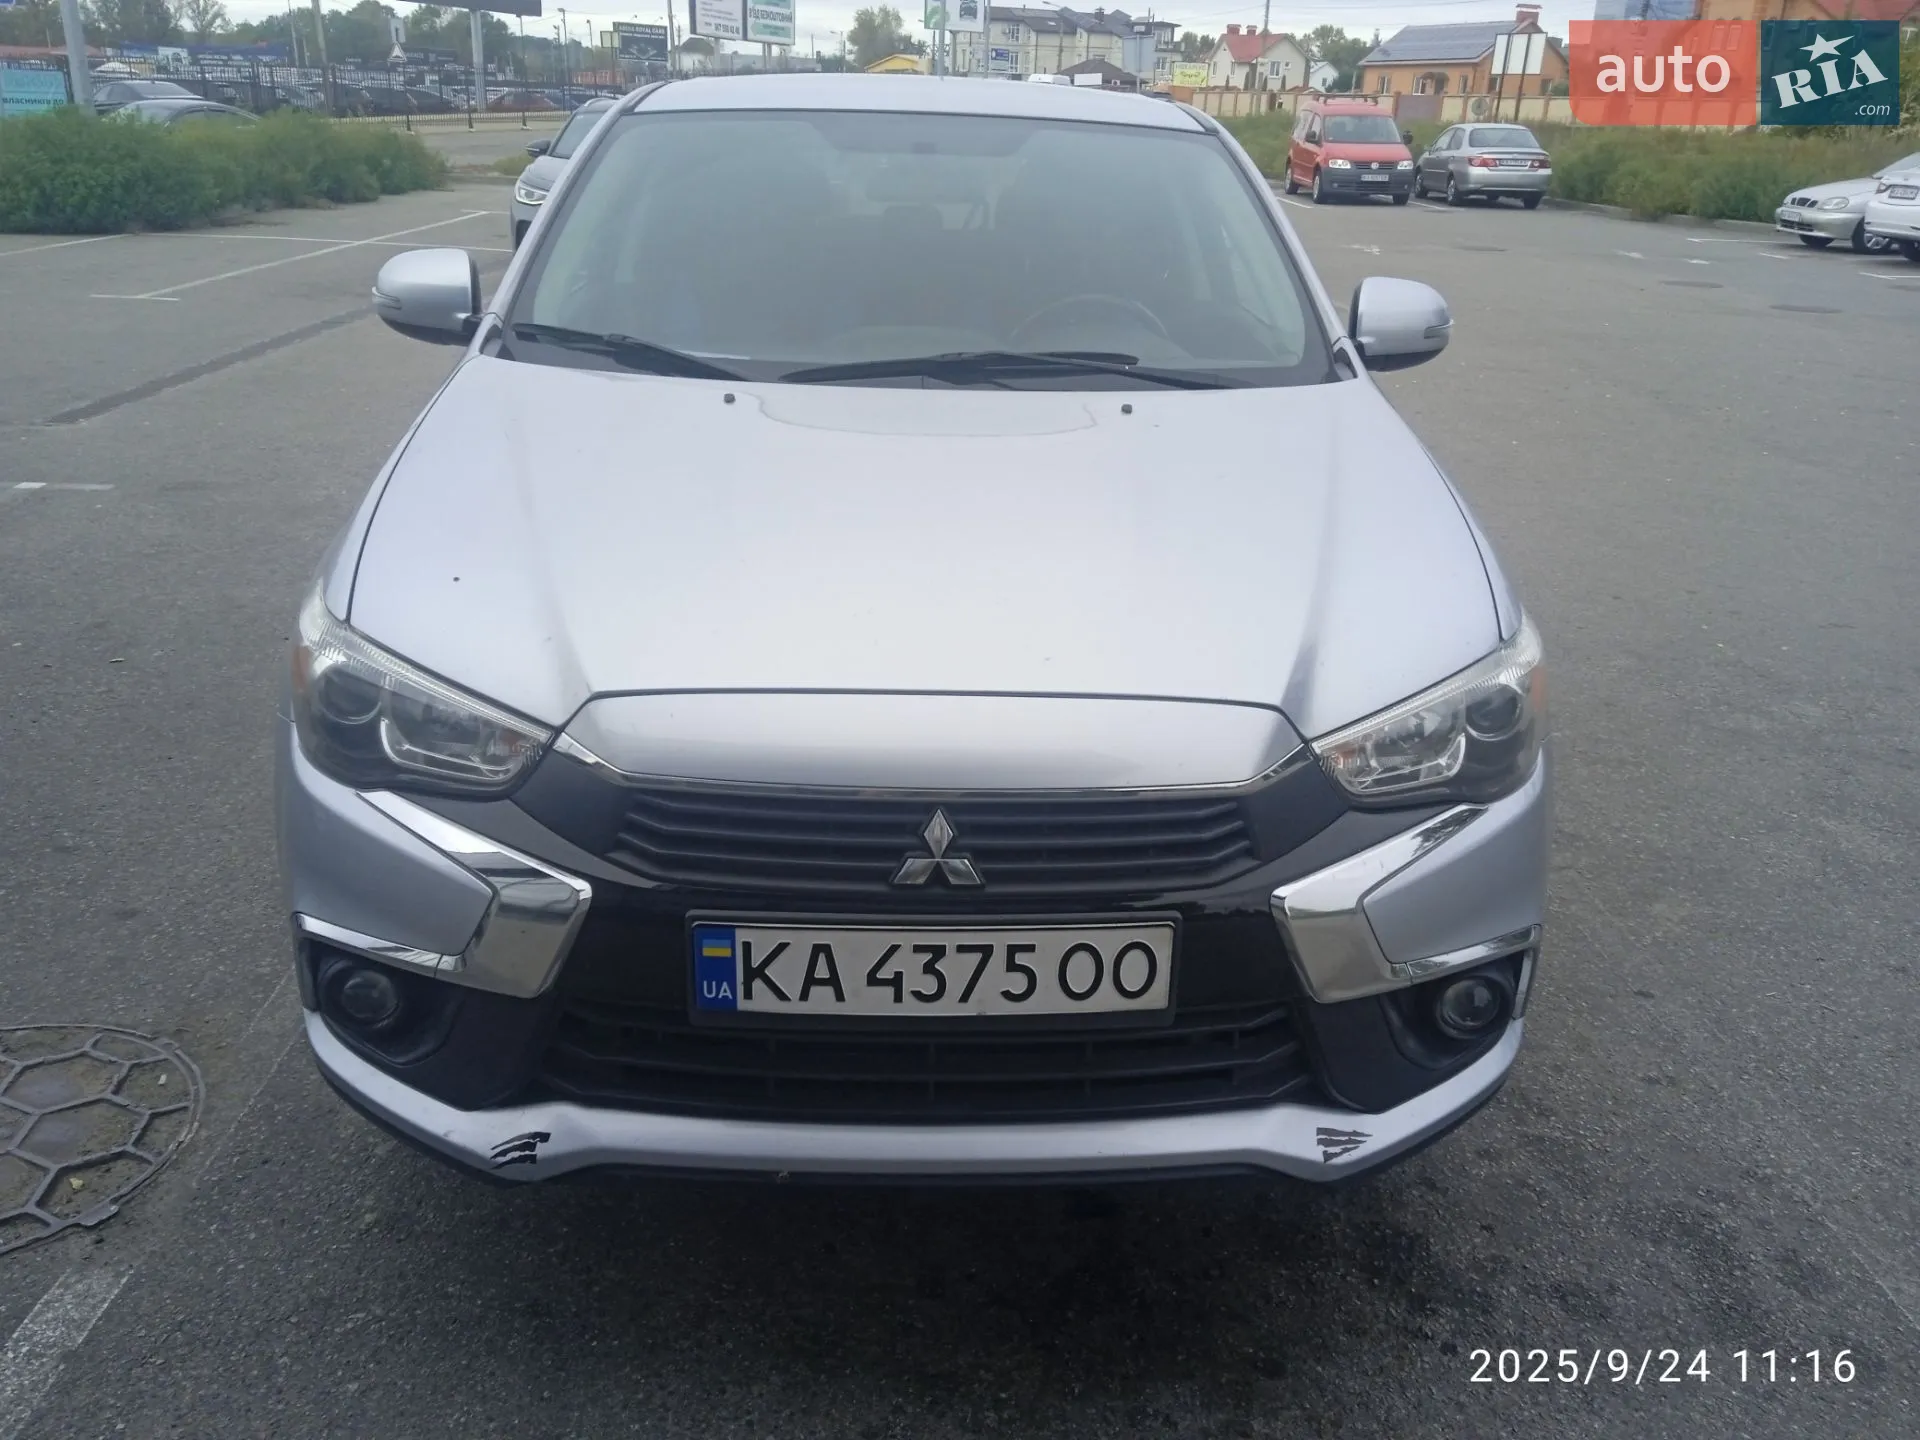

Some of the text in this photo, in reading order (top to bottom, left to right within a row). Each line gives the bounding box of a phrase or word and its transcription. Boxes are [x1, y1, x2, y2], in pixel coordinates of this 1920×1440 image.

[703, 980, 734, 1000] UA
[741, 940, 846, 1002] KA
[866, 943, 1038, 1003] 4375
